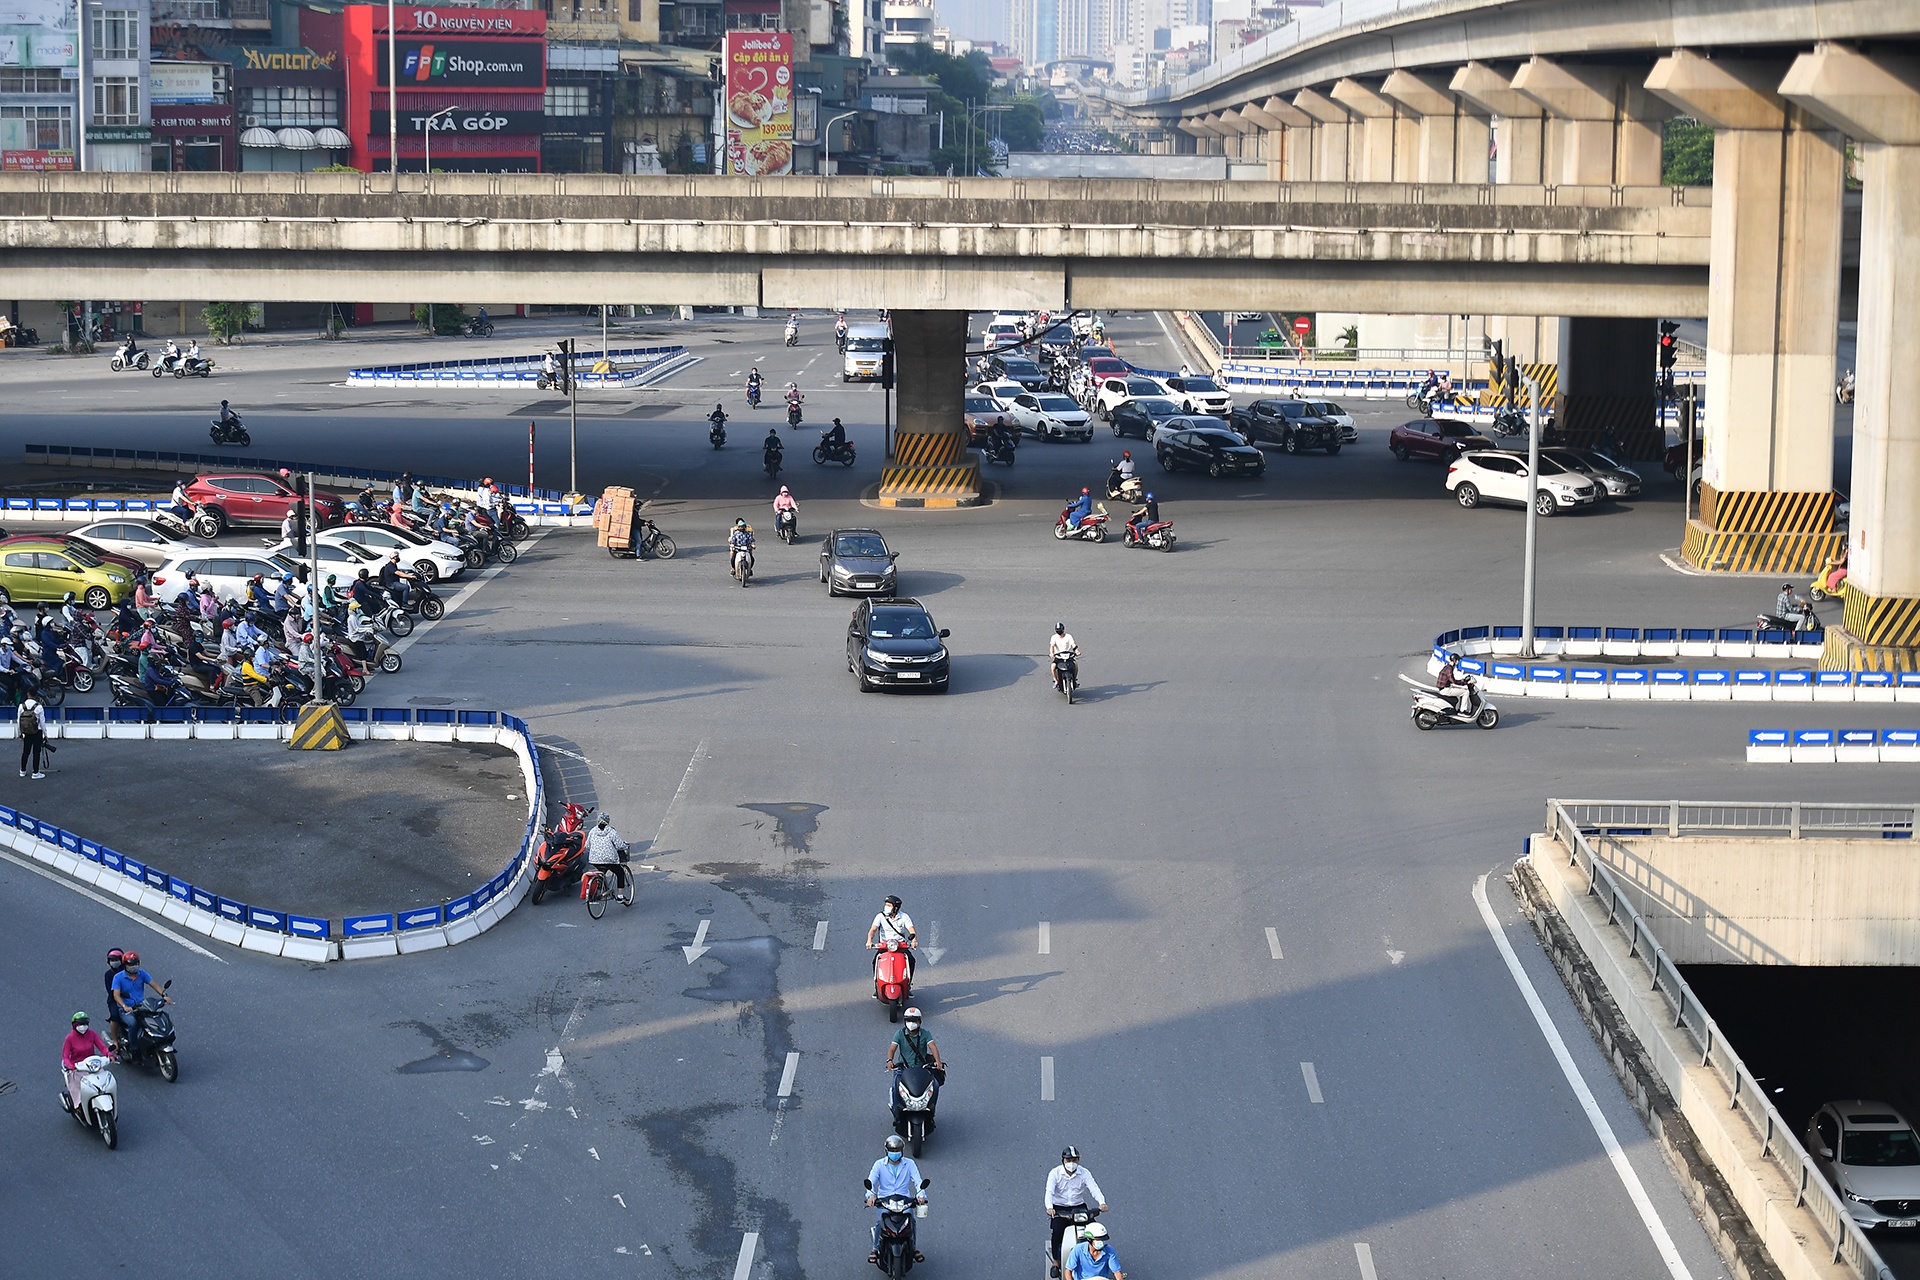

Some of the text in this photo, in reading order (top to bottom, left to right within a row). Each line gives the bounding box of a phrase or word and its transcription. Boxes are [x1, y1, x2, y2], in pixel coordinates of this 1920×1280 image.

[413, 10, 438, 29] 10
[742, 39, 772, 50] Jollibee
[449, 55, 523, 76] Shop.com.vn
[161, 118, 177, 127] KEM
[201, 118, 219, 127] SINH
[411, 112, 508, 131] TRẢ GÓP
[6, 156, 18, 164] HÀ
[20, 157, 34, 166] NỘI
[41, 157, 56, 166] NỘI
[58, 156, 72, 164] BÀI
